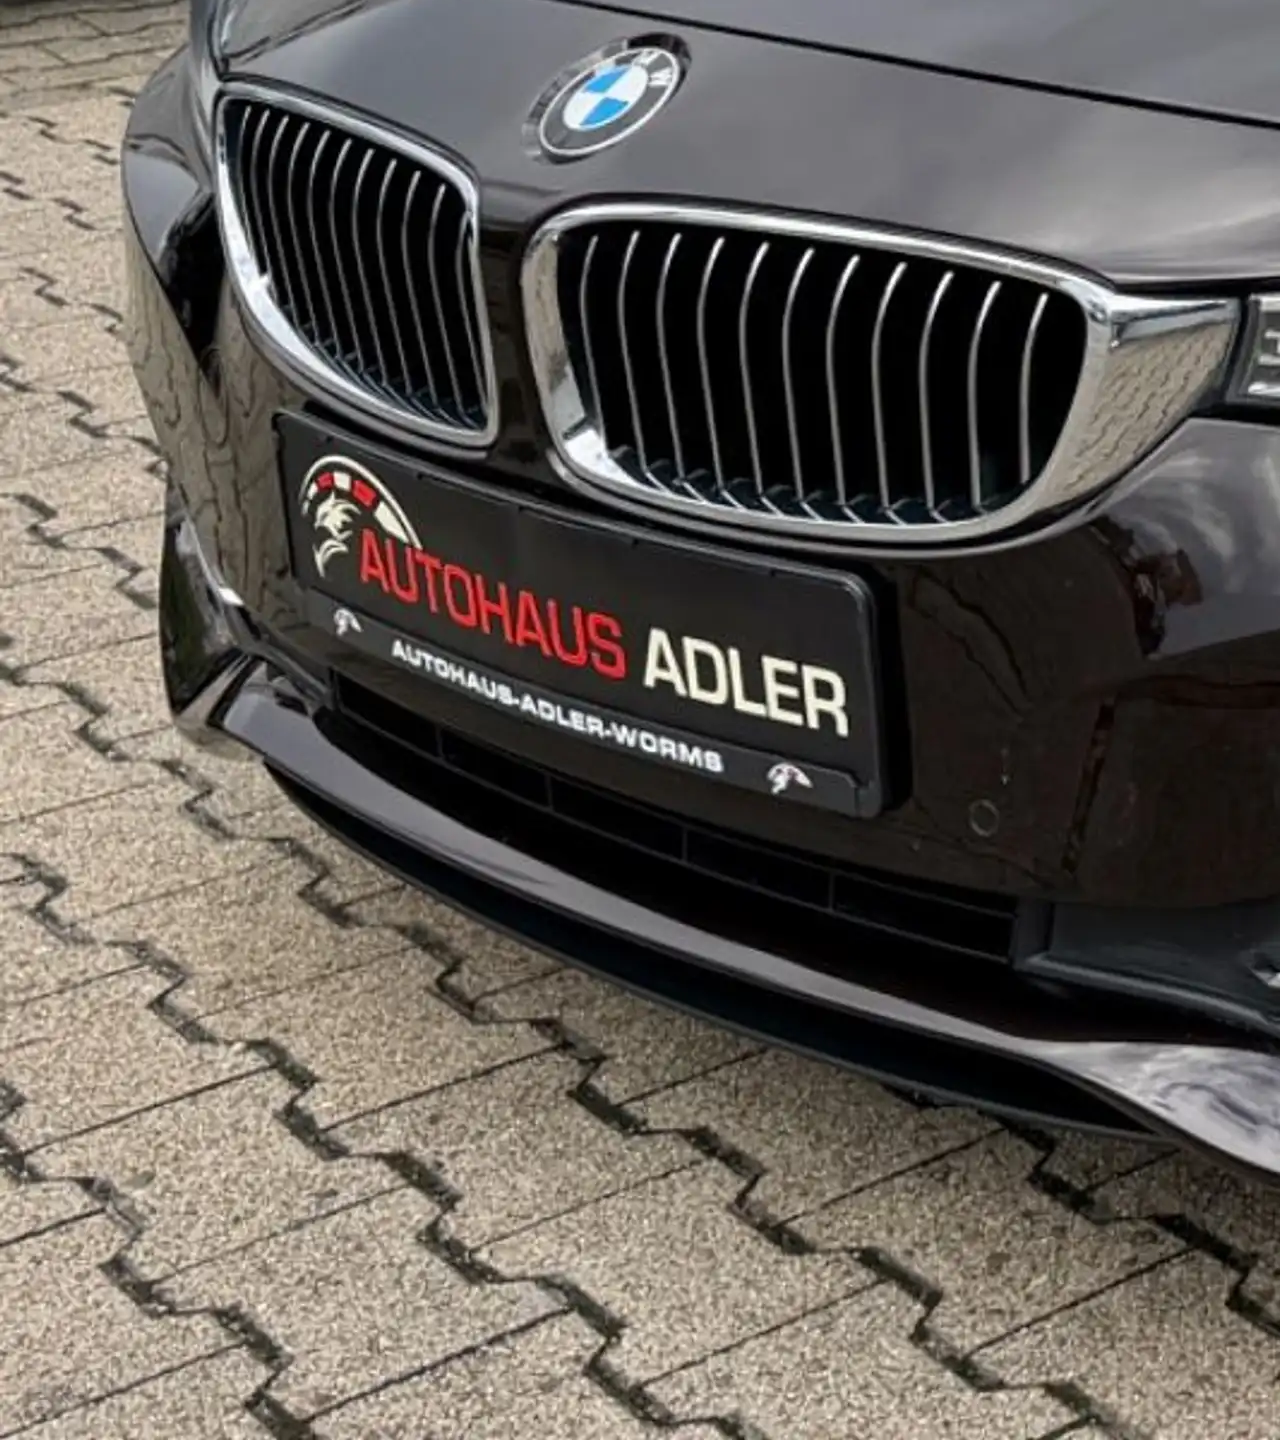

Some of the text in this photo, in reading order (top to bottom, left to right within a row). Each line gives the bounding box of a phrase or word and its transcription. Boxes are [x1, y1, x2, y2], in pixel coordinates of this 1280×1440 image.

[359, 528, 850, 738] AUTOHAUS ADLER
[391, 639, 725, 774] AUTOHAUS-ADLER-WORMS
